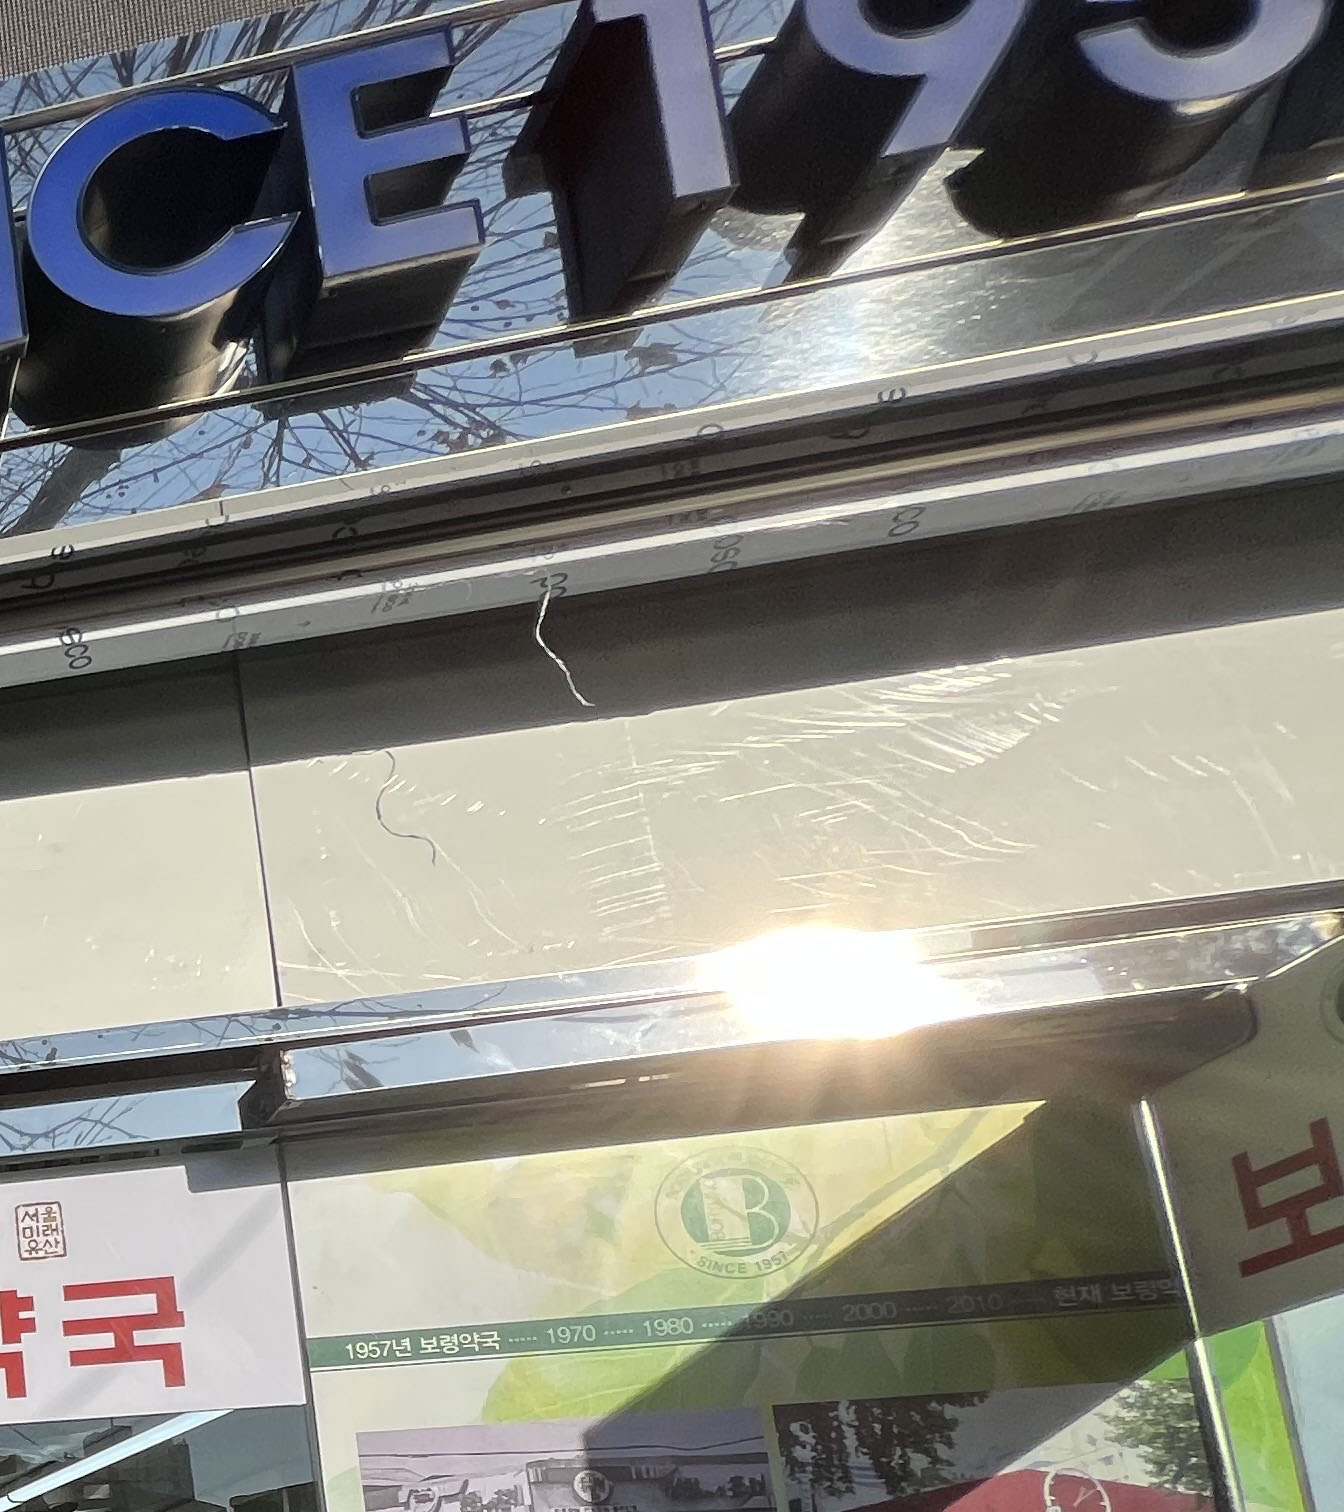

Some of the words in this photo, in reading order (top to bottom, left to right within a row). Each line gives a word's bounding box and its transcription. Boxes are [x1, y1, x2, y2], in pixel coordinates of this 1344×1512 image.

[20, 1206, 58, 1223] 서울
[22, 1224, 60, 1241] 미래
[23, 1240, 62, 1257] 유산
[696, 1255, 747, 1275] SINCE
[754, 1250, 789, 1272] 1957
[345, 1338, 412, 1361] 1957년
[419, 1330, 501, 1355] 보령약국
[546, 1325, 597, 1346] 1970
[642, 1317, 693, 1338] 1980
[841, 1301, 897, 1323] 2000
[945, 1292, 1004, 1315] 2010
[1052, 1281, 1104, 1309] 현재
